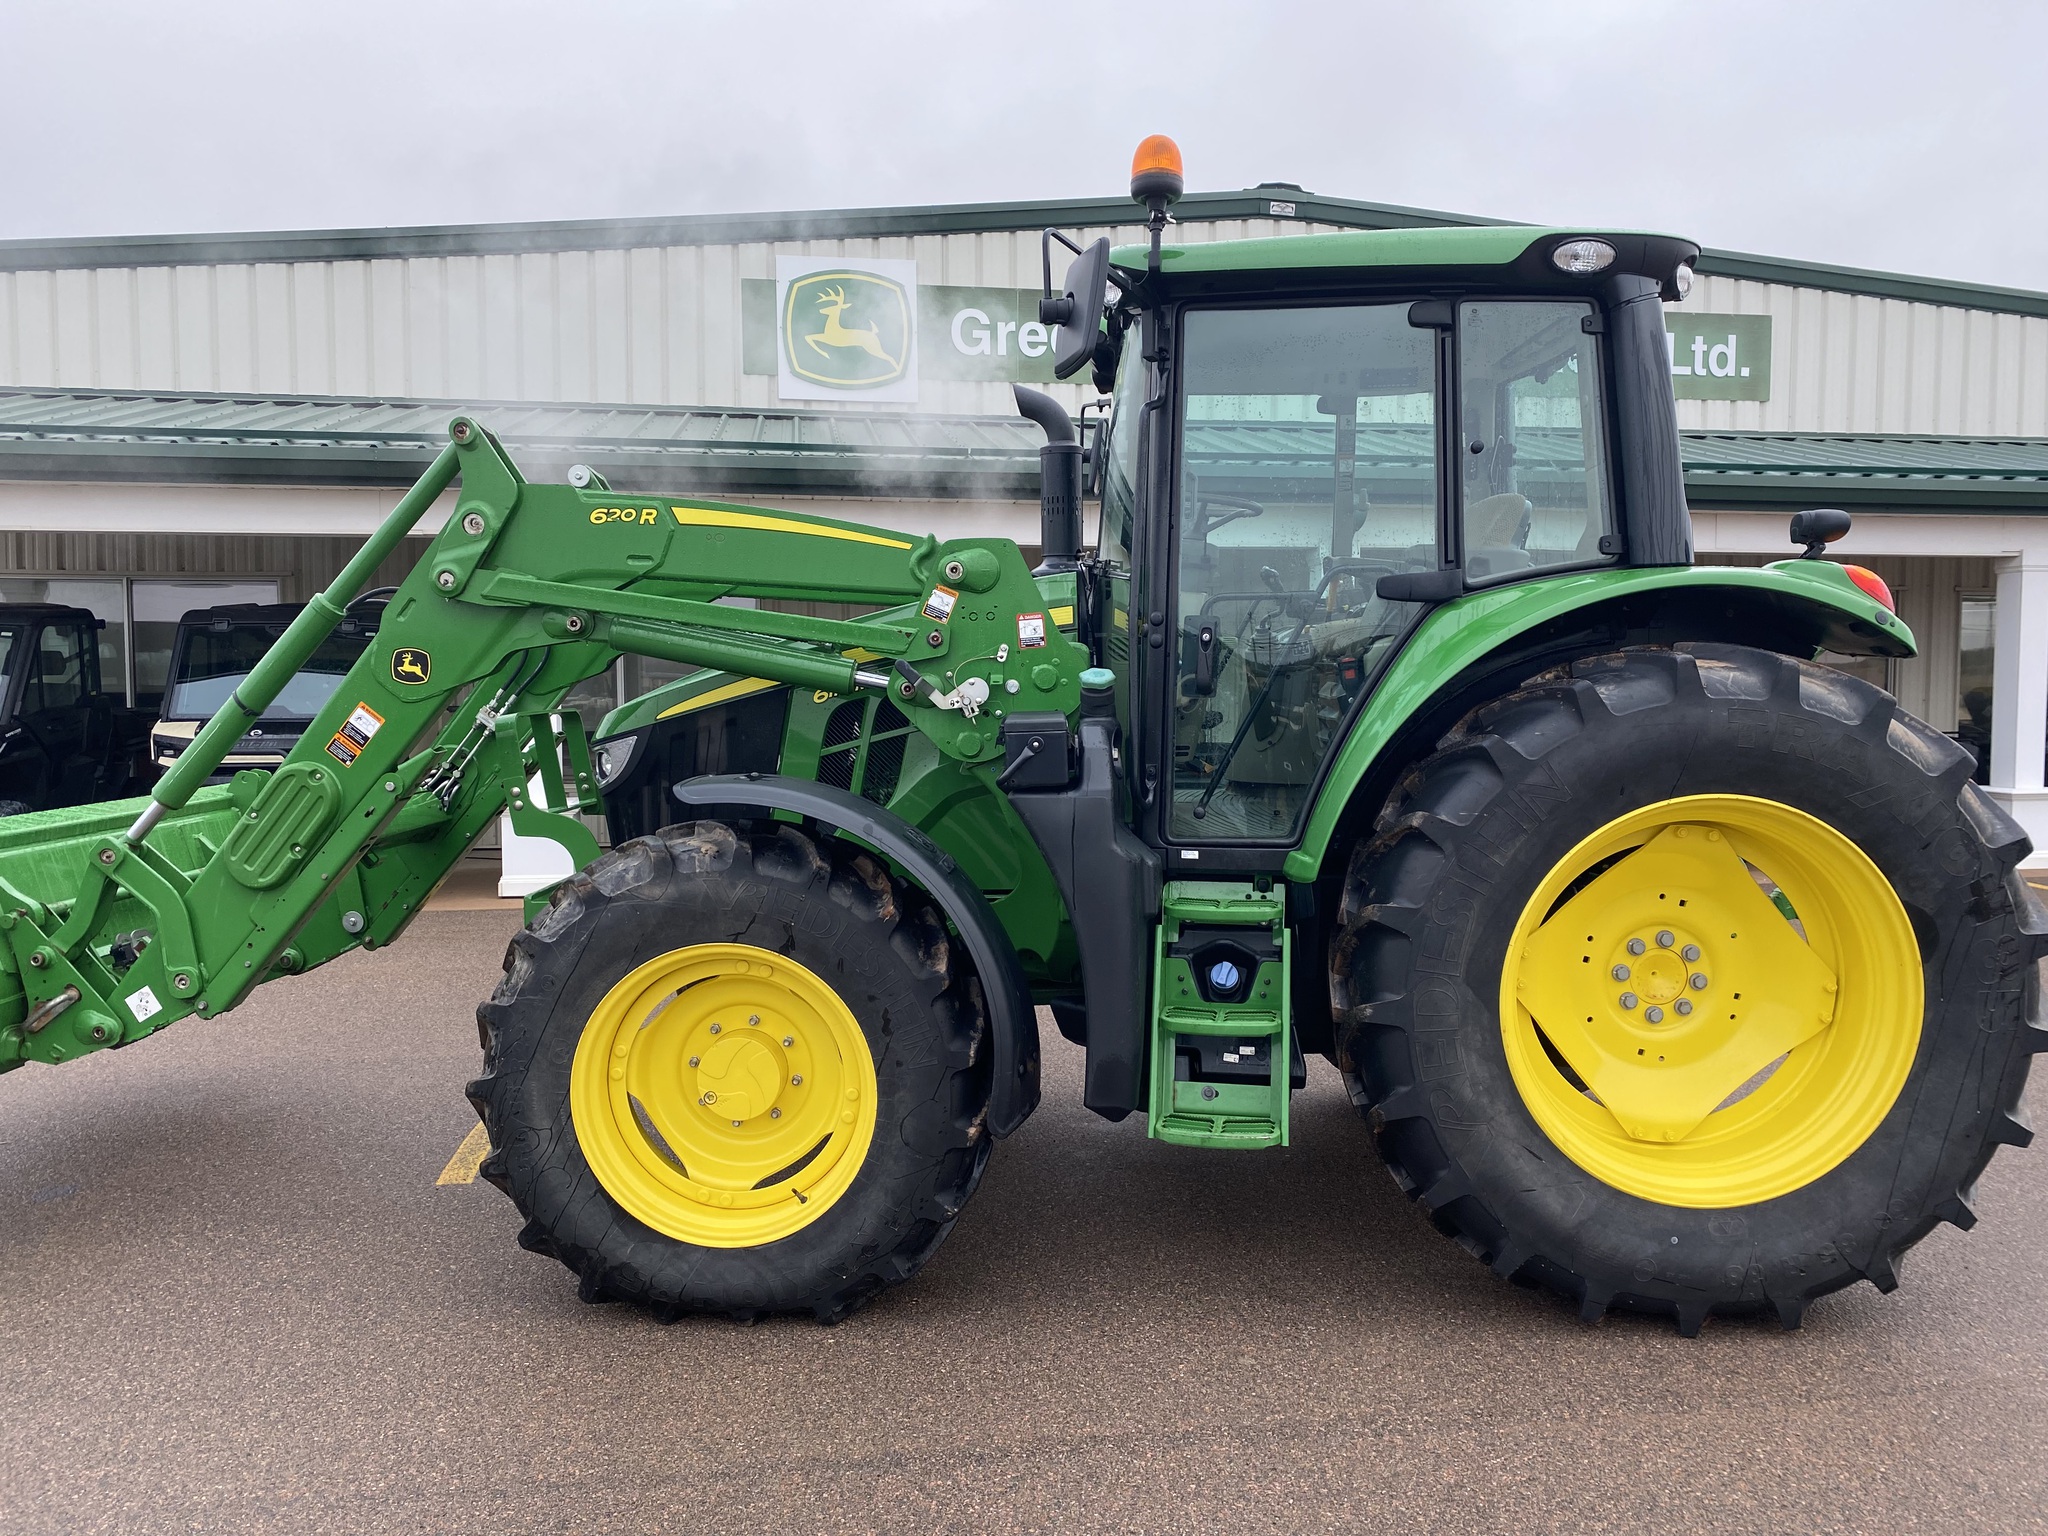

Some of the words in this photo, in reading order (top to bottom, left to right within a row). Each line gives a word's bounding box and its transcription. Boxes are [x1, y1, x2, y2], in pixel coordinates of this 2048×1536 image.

[949, 307, 1058, 358] Gre
[1666, 332, 1750, 377] Ltd.
[701, 876, 939, 1070] VREDESTEIN
[1412, 759, 1574, 1182] VREDESTEIN
